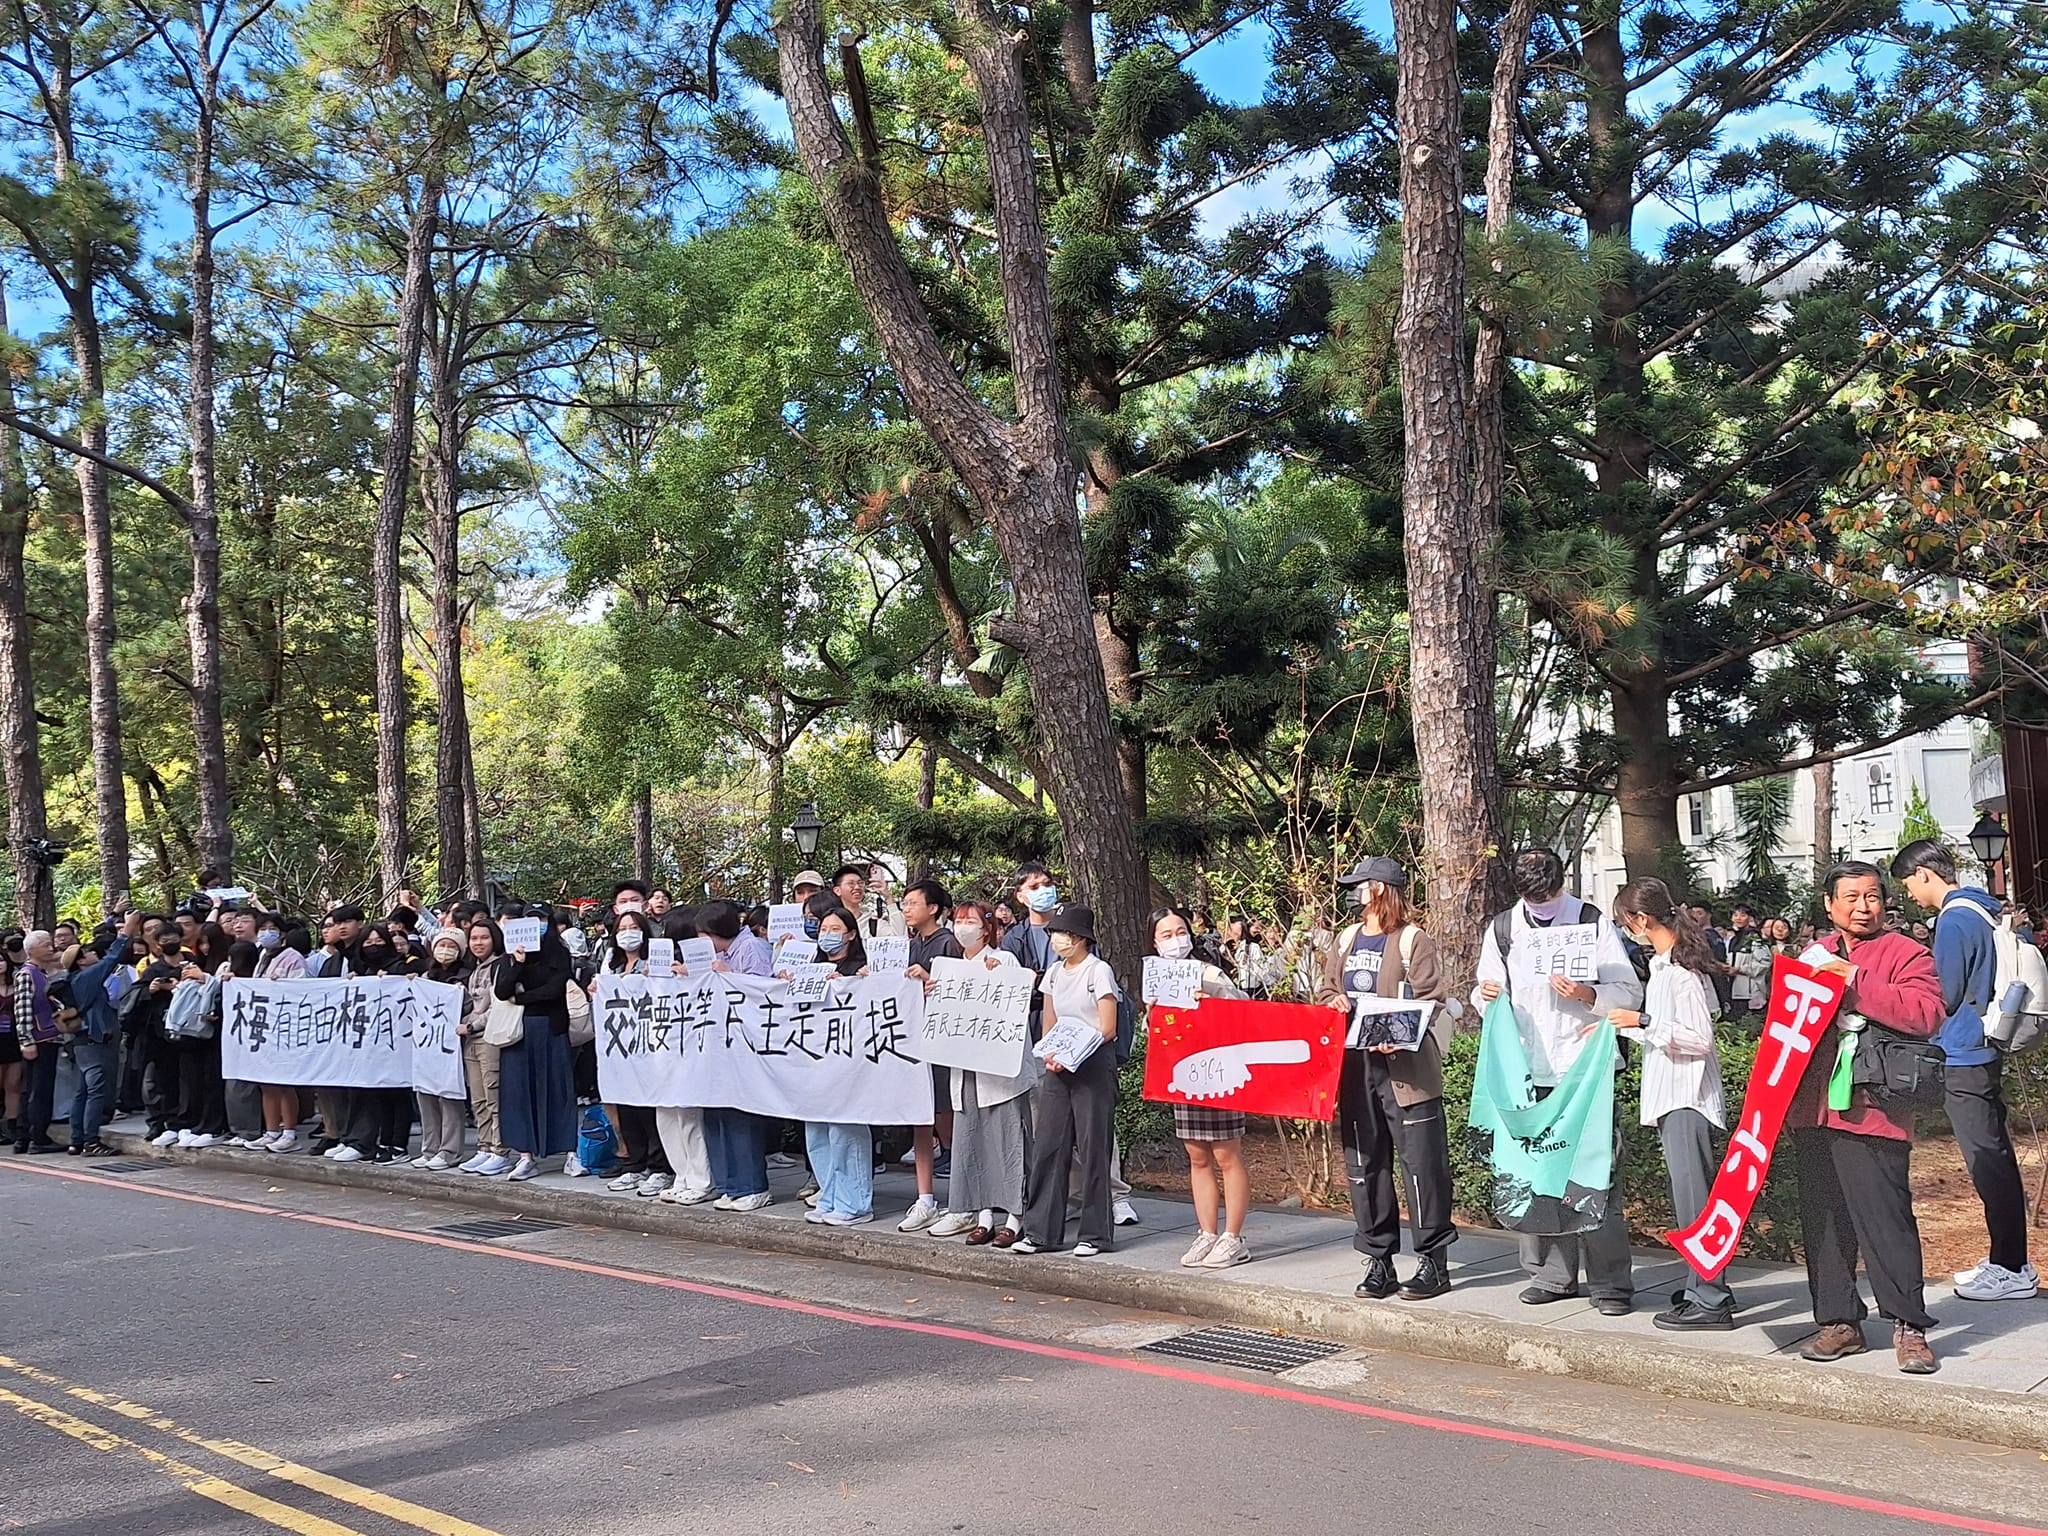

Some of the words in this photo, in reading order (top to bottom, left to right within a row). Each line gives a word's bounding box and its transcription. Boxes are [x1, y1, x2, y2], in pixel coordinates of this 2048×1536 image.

[929, 973, 1031, 1013] 有主權才有平等
[923, 1012, 1025, 1043] 有民主才有交流
[1188, 1058, 1224, 1085] 8964
